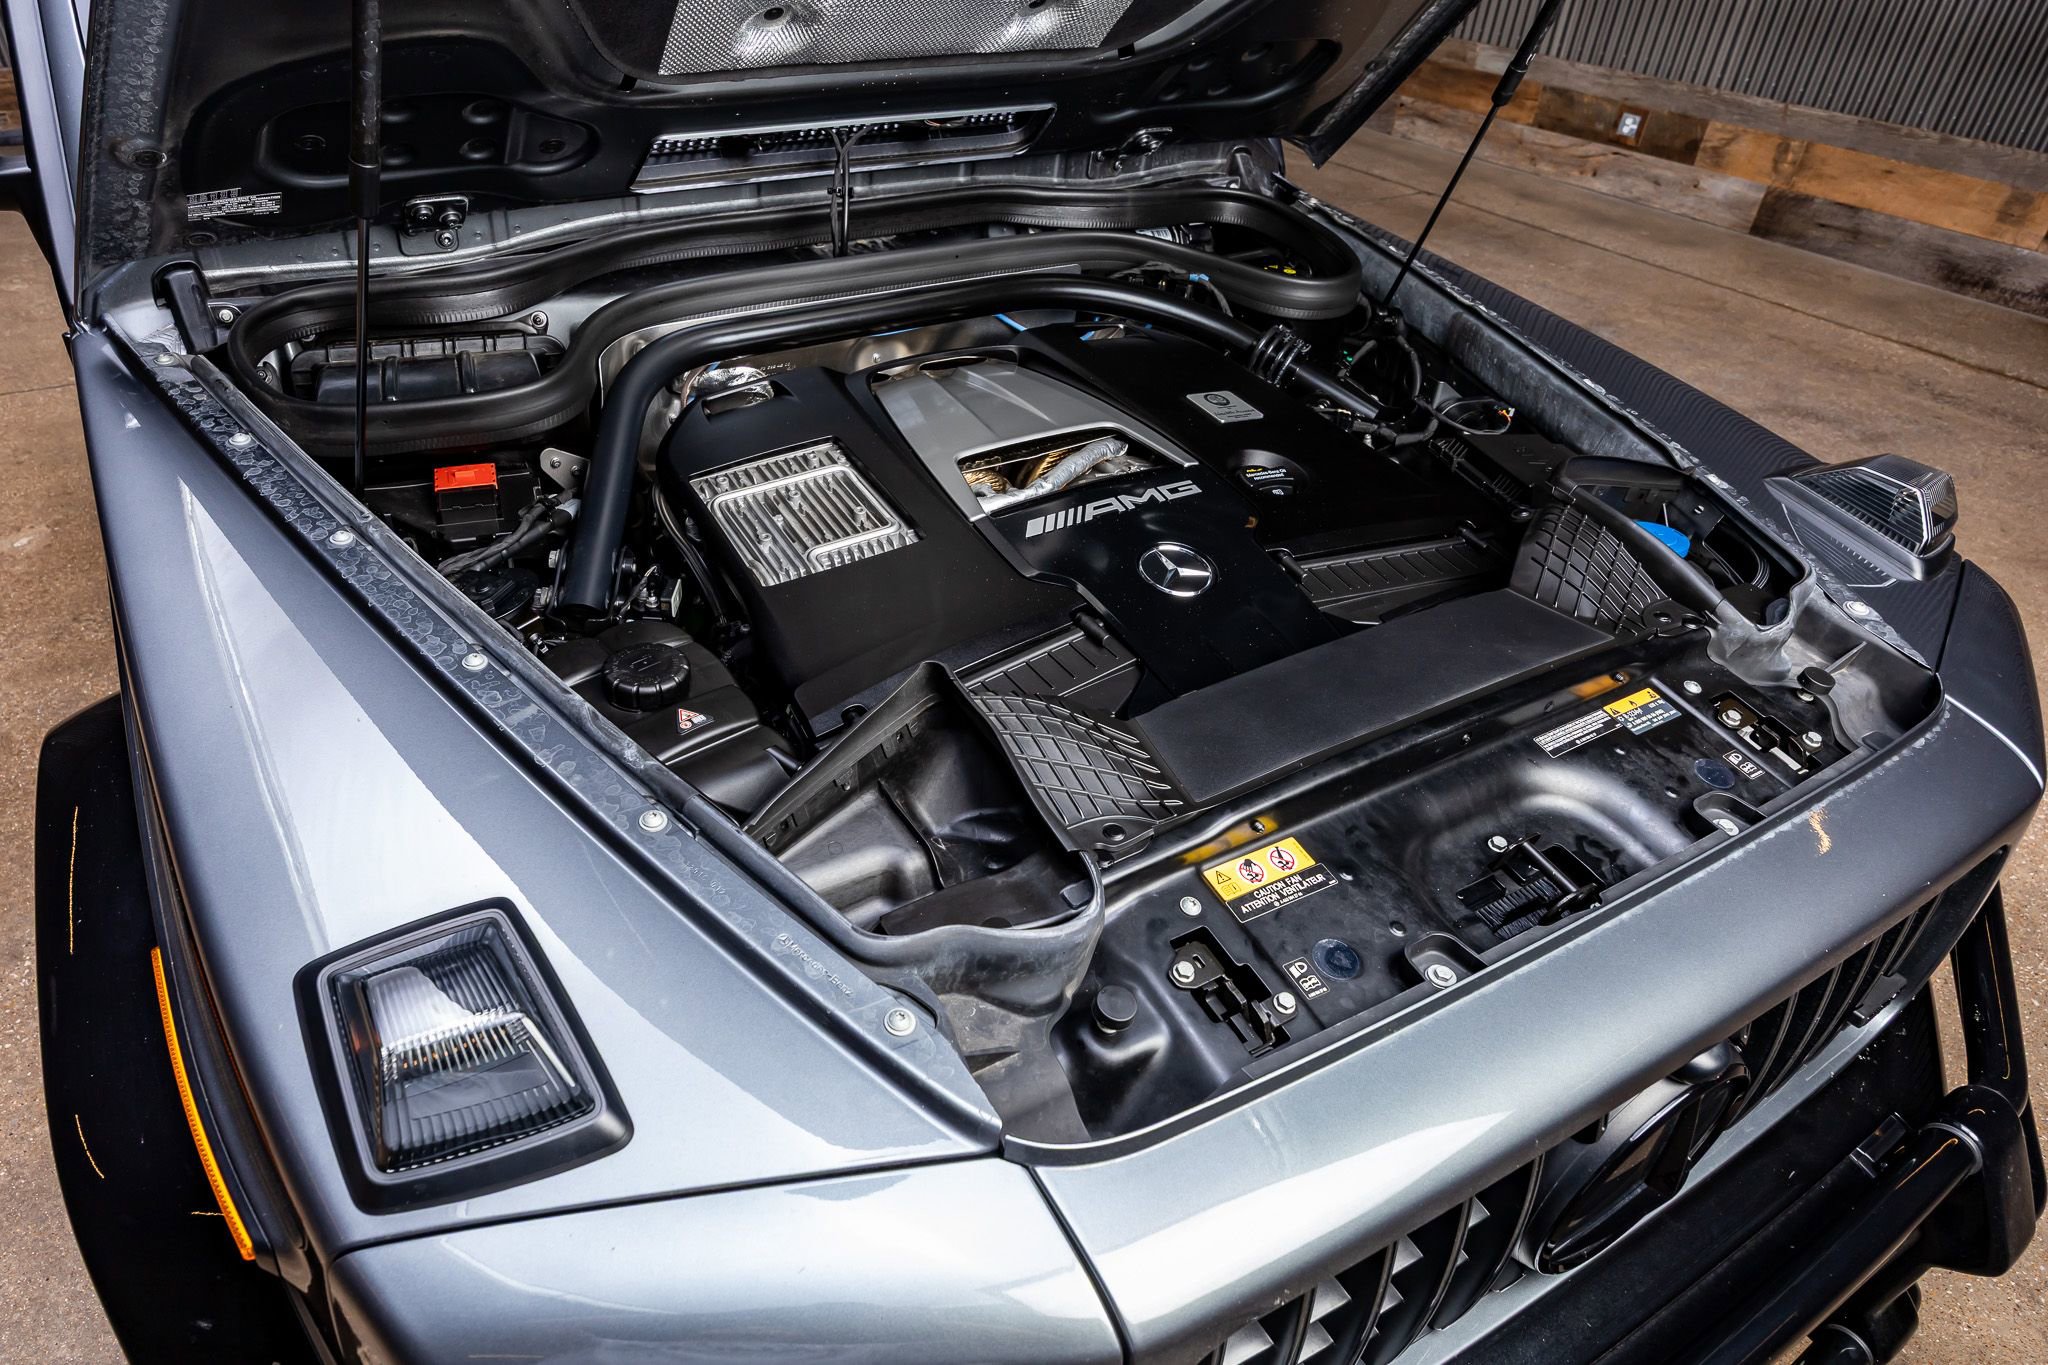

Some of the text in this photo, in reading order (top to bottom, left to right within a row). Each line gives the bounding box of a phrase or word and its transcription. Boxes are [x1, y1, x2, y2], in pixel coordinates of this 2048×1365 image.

[1084, 480, 1202, 522] AMG
[1241, 892, 1280, 913] ATTENTION
[1281, 873, 1326, 896] VENTILATEUR
[1254, 874, 1303, 898] CAUTION FAN
[788, 940, 854, 998] Mercedes-Benz
